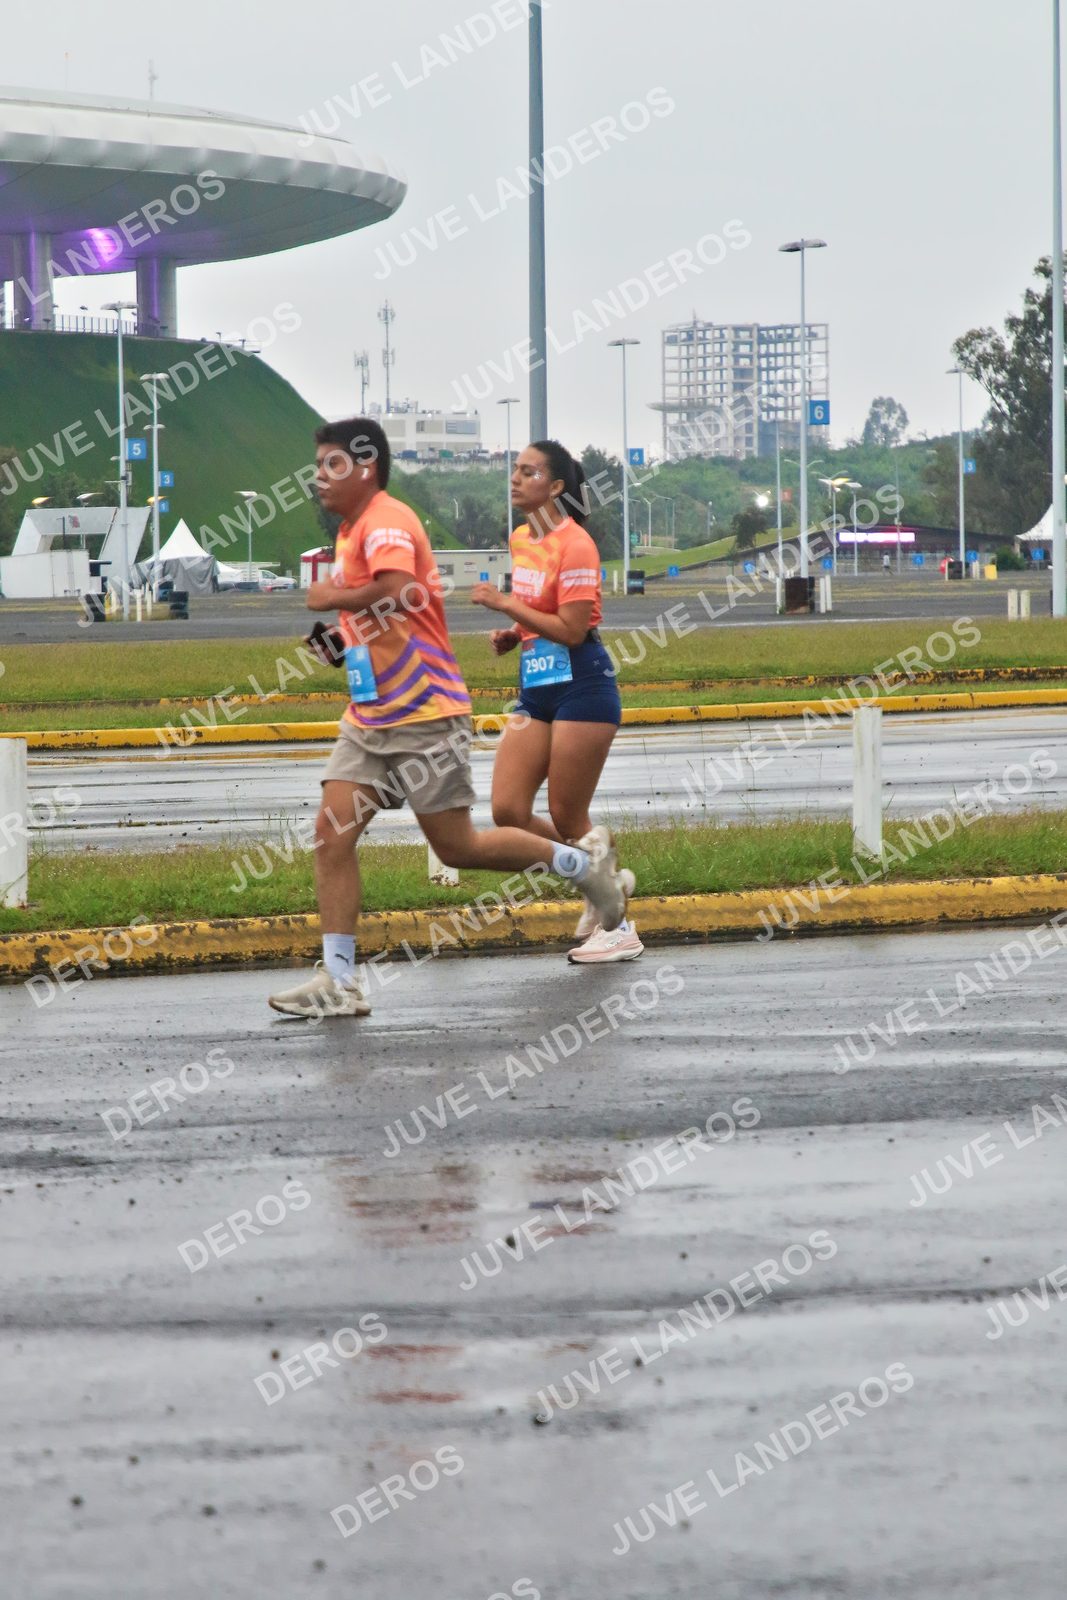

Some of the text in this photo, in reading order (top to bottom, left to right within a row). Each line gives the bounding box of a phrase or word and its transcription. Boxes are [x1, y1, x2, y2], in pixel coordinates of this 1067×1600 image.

[814, 405, 824, 420] 6
[132, 443, 141, 456] 5
[632, 451, 640, 462] 4
[164, 474, 170, 484] 3
[525, 655, 554, 674] 2907
